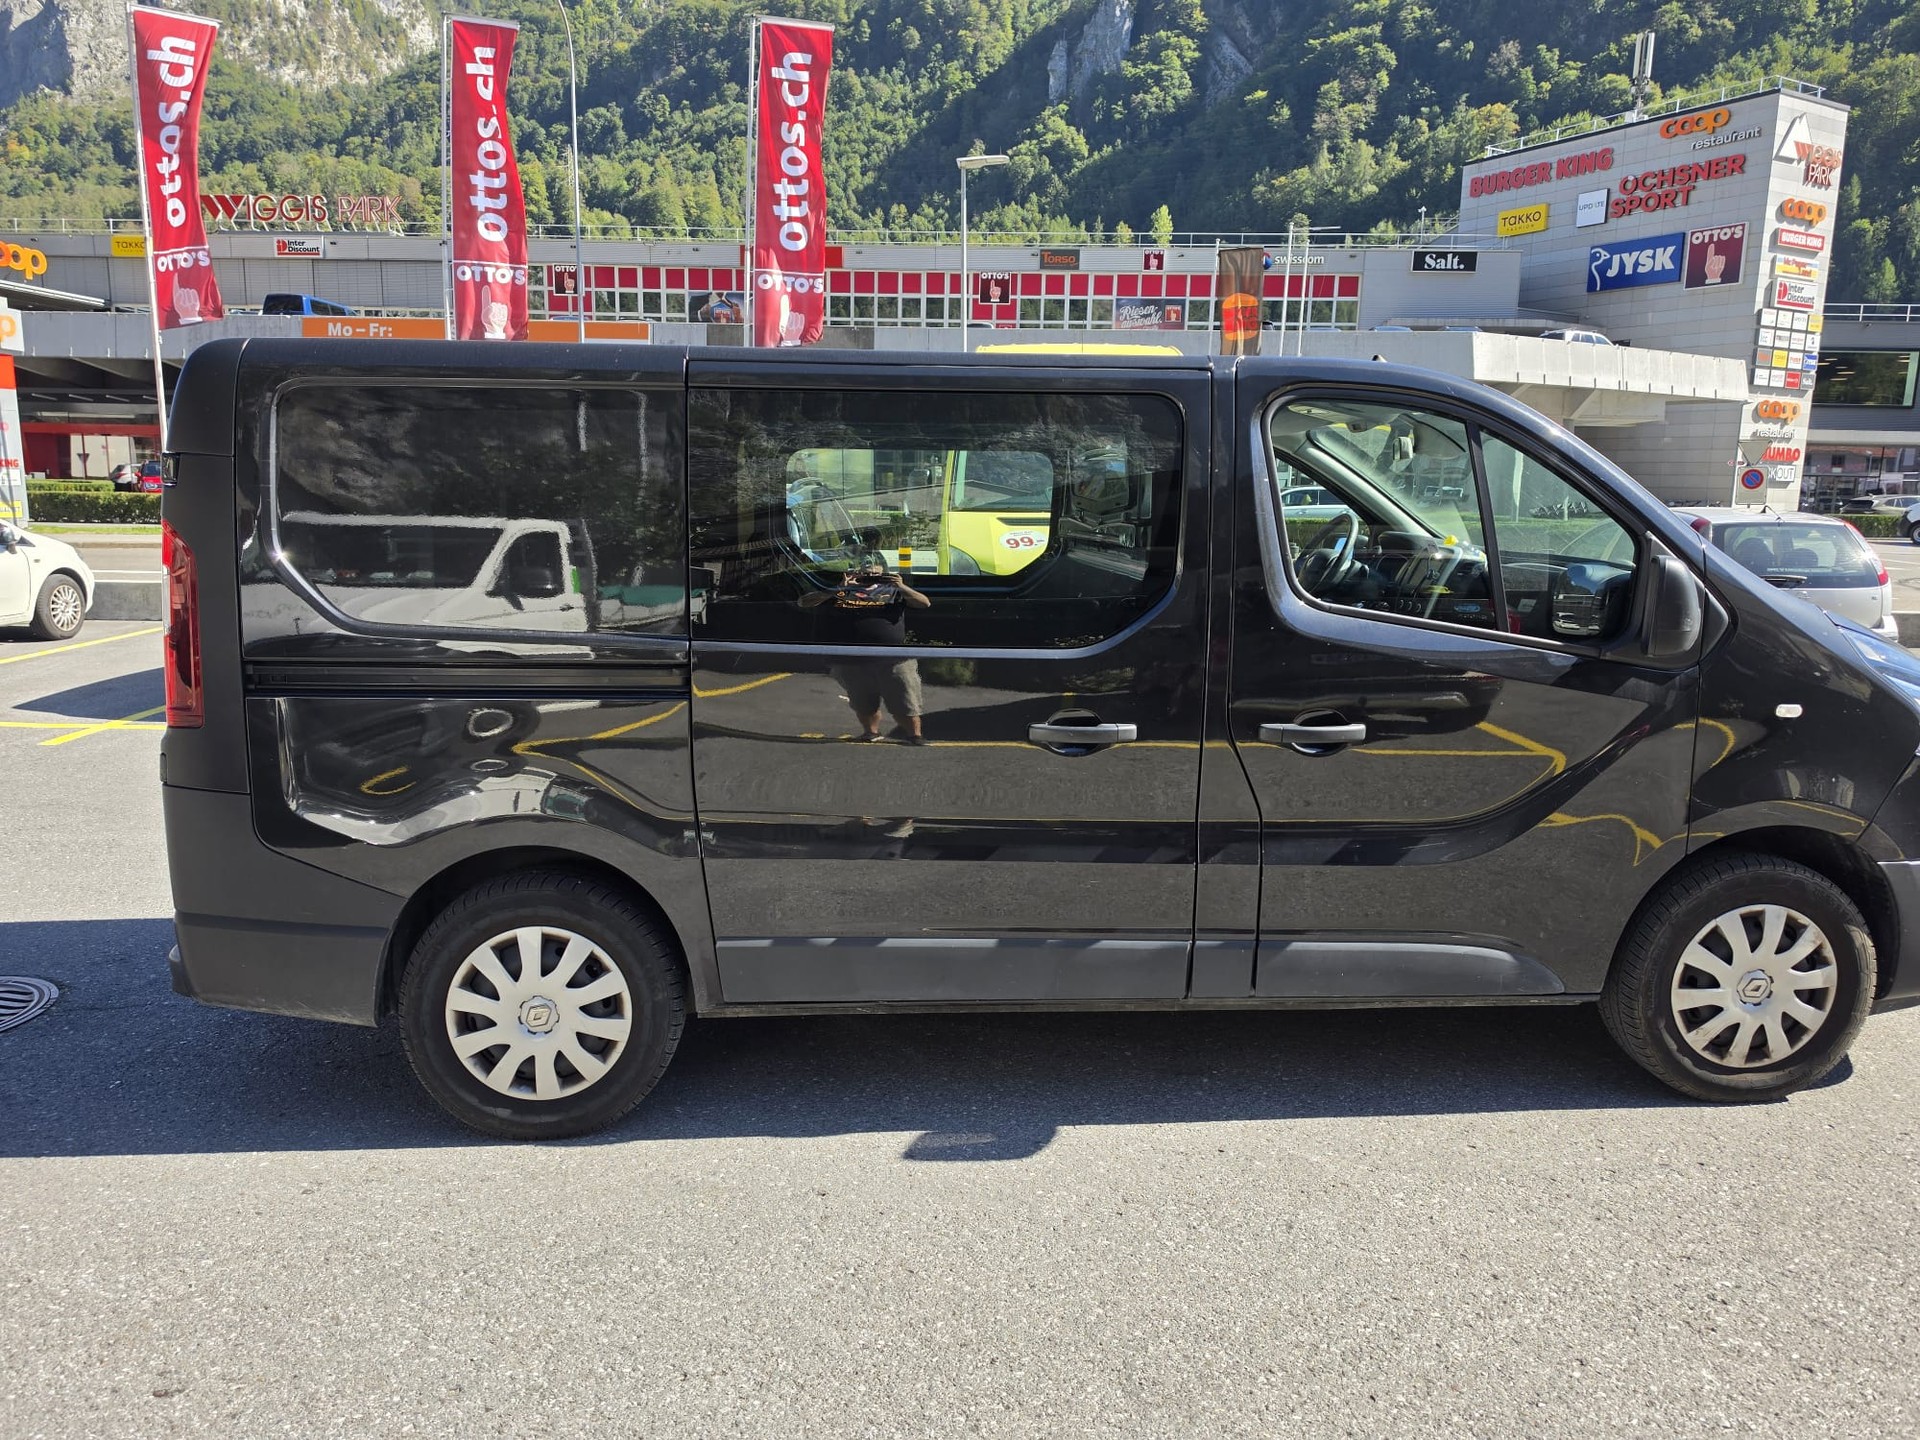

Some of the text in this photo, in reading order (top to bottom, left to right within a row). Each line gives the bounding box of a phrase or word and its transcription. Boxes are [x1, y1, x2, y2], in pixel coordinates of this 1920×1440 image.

[147, 36, 196, 228] ottos.ch
[1659, 107, 1730, 139] coop
[466, 46, 508, 242] ottos.ch
[1691, 126, 1761, 150] restaurant
[771, 51, 813, 252] ottos.ch
[1469, 147, 1614, 198] BURGER KING
[1619, 153, 1746, 195] OCHSNER
[1807, 163, 1832, 186] PARK
[200, 194, 405, 224] WIGGIS PARK
[1610, 184, 1695, 218] SPORT
[1784, 197, 1827, 229] coop
[287, 239, 305, 247] Inter
[1691, 225, 1744, 245] OTTO'S
[157, 250, 210, 273] OTTO'S
[1424, 252, 1465, 270] Salt.
[1606, 245, 1677, 278] JYSK
[456, 265, 526, 286] OTTO'S
[757, 273, 824, 294] OTTO'S
[981, 272, 1010, 280] OTTO'S
[1787, 292, 1815, 304] Discount
[1789, 283, 1805, 294] Inter
[327, 322, 353, 337] Mo
[369, 322, 393, 337] Fr:
[1758, 399, 1801, 425] coop
